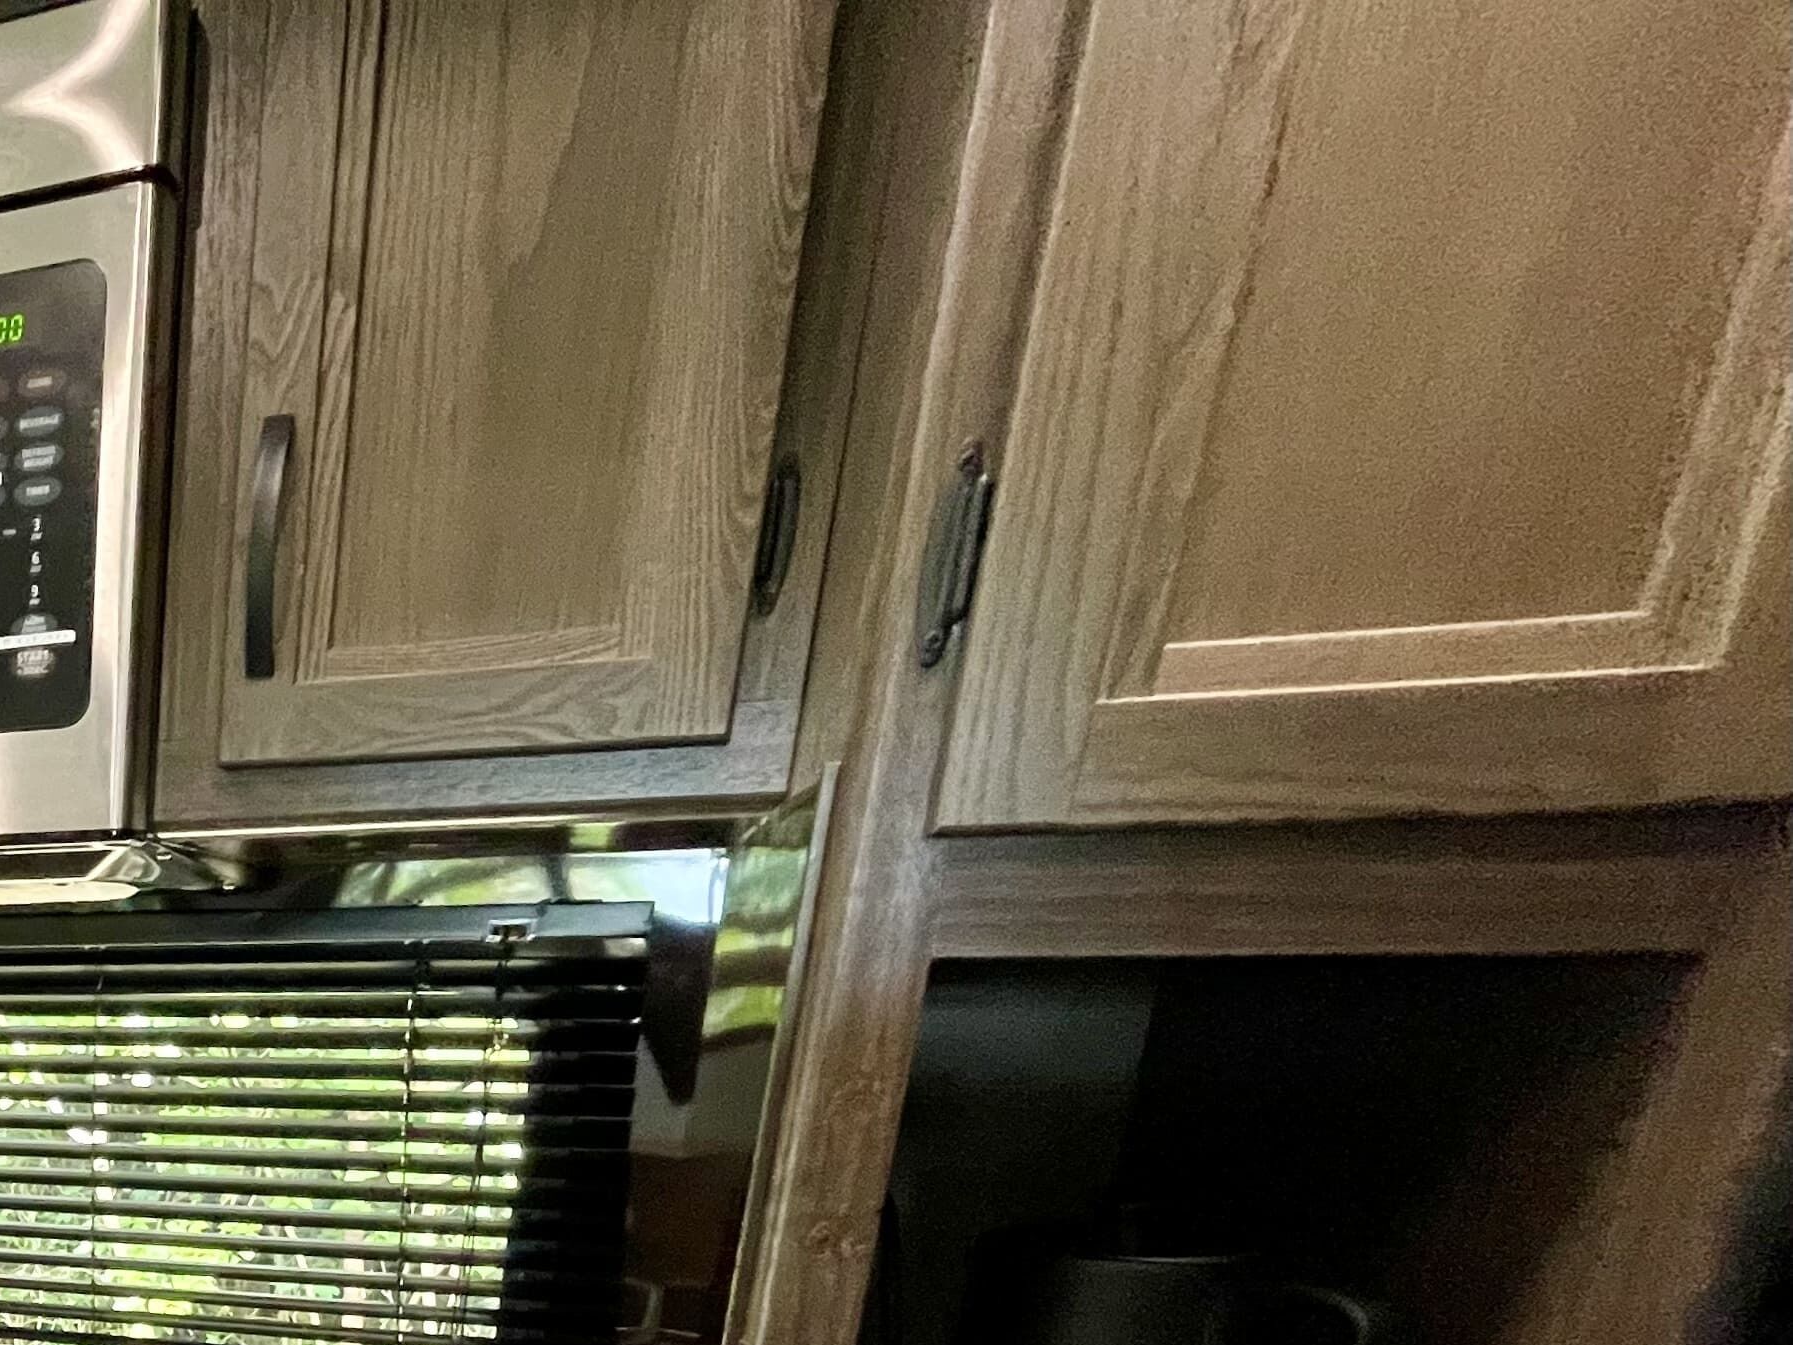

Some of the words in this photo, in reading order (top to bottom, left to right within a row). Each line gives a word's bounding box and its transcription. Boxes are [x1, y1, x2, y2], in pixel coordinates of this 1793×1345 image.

[32, 517, 41, 532] 3
[31, 551, 40, 564] 6
[30, 584, 39, 597] 9
